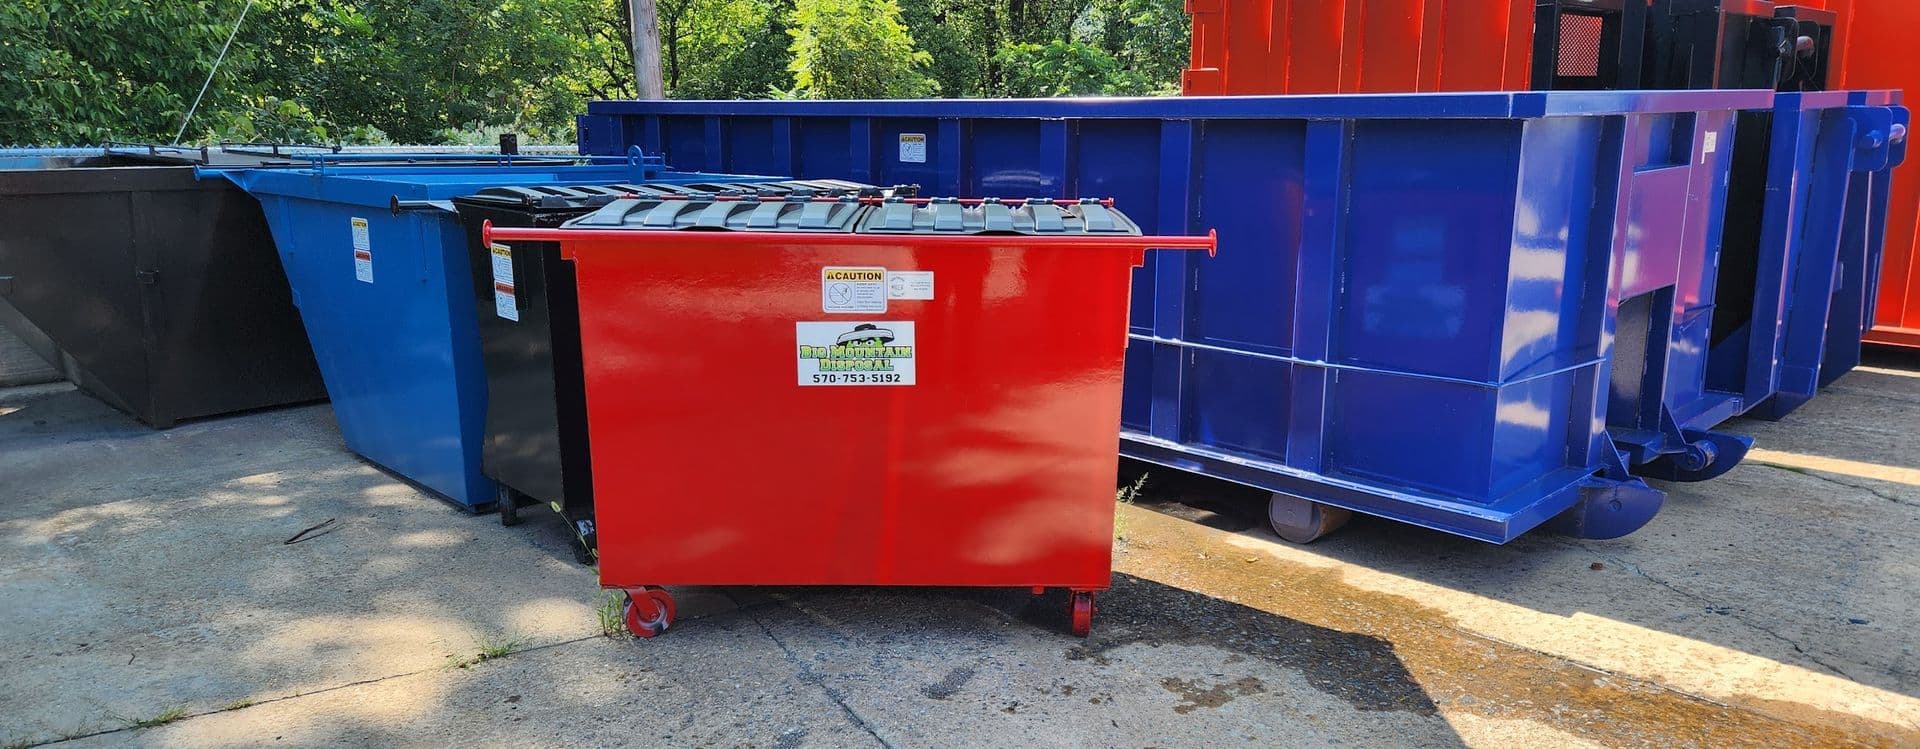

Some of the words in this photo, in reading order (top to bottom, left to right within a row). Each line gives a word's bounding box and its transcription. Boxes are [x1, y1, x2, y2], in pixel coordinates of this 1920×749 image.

[835, 272, 882, 280] CAUTION
[800, 345, 827, 358] BIG
[830, 345, 912, 358] MOUNTAIN
[819, 359, 894, 371] DISPOSAL
[813, 374, 901, 382] 570-753-5192
